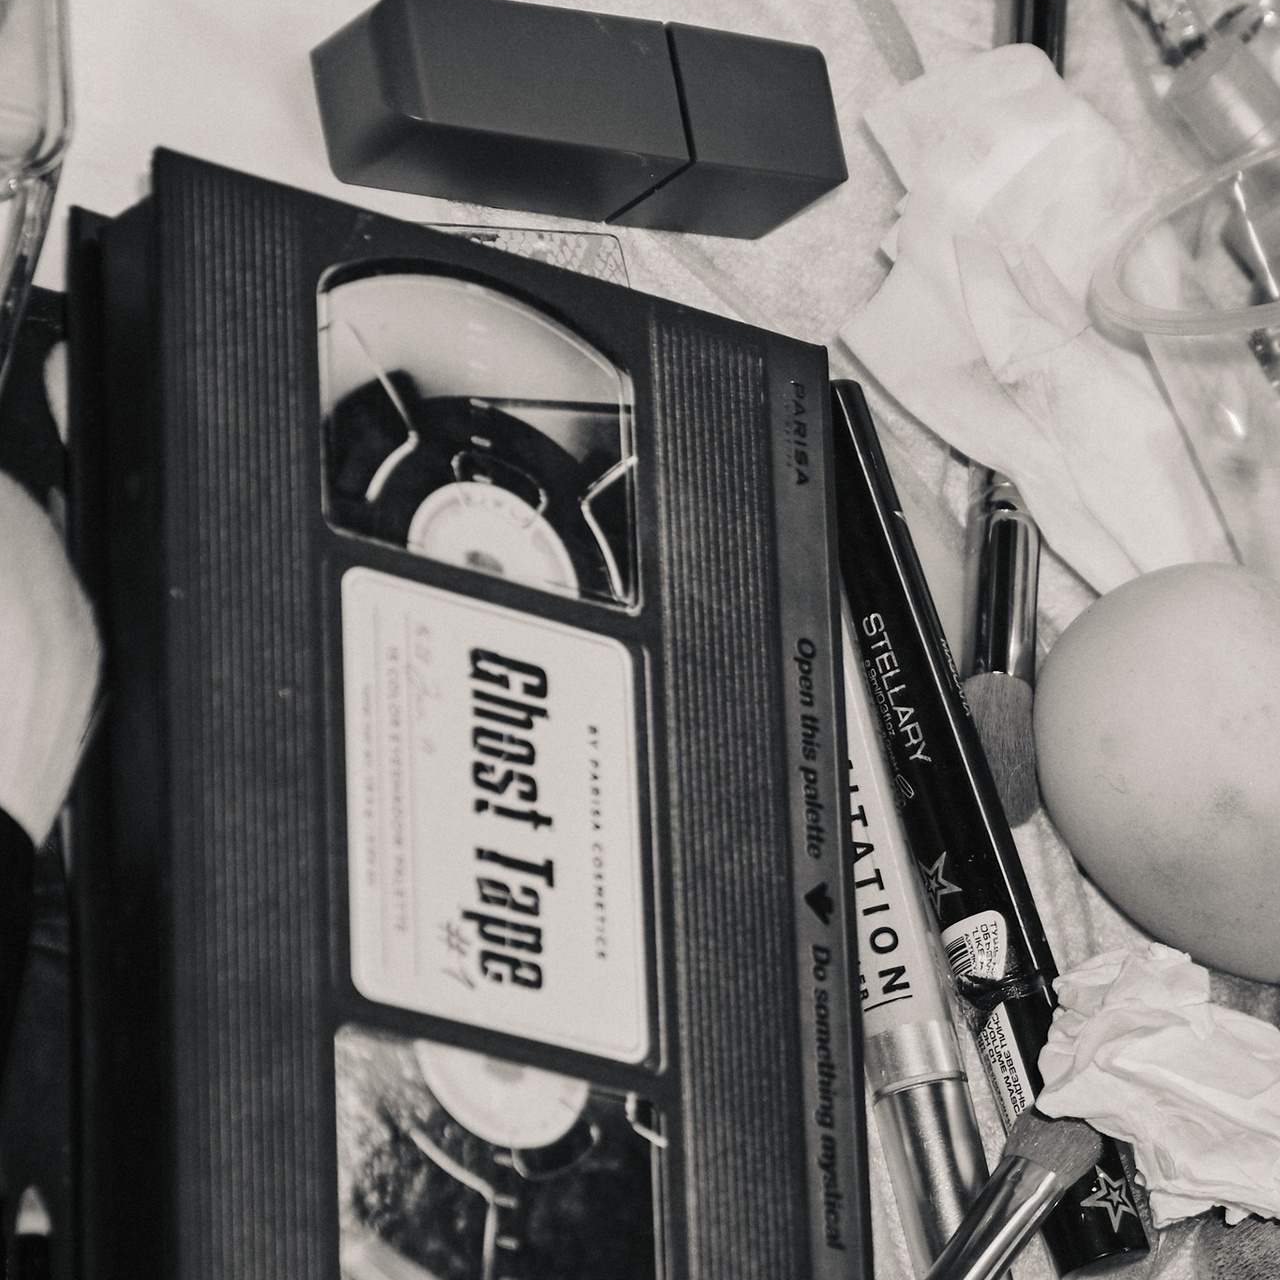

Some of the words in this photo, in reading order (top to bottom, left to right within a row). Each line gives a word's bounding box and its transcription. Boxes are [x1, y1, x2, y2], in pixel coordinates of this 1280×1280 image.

[786, 381, 811, 486] PARISA
[796, 636, 818, 705] Open
[857, 610, 934, 769] STELLARY
[462, 641, 558, 835] Ghost
[799, 706, 820, 762] this
[588, 758, 604, 831] PARISA
[801, 765, 825, 861] palette
[456, 840, 563, 996] Tape
[847, 757, 912, 997] TATION
[811, 942, 832, 984] Do
[812, 987, 839, 1132] something
[981, 1020, 1010, 1074] VOLUME
[1000, 1074, 1025, 1117] MASC
[816, 1133, 846, 1253] mystical
